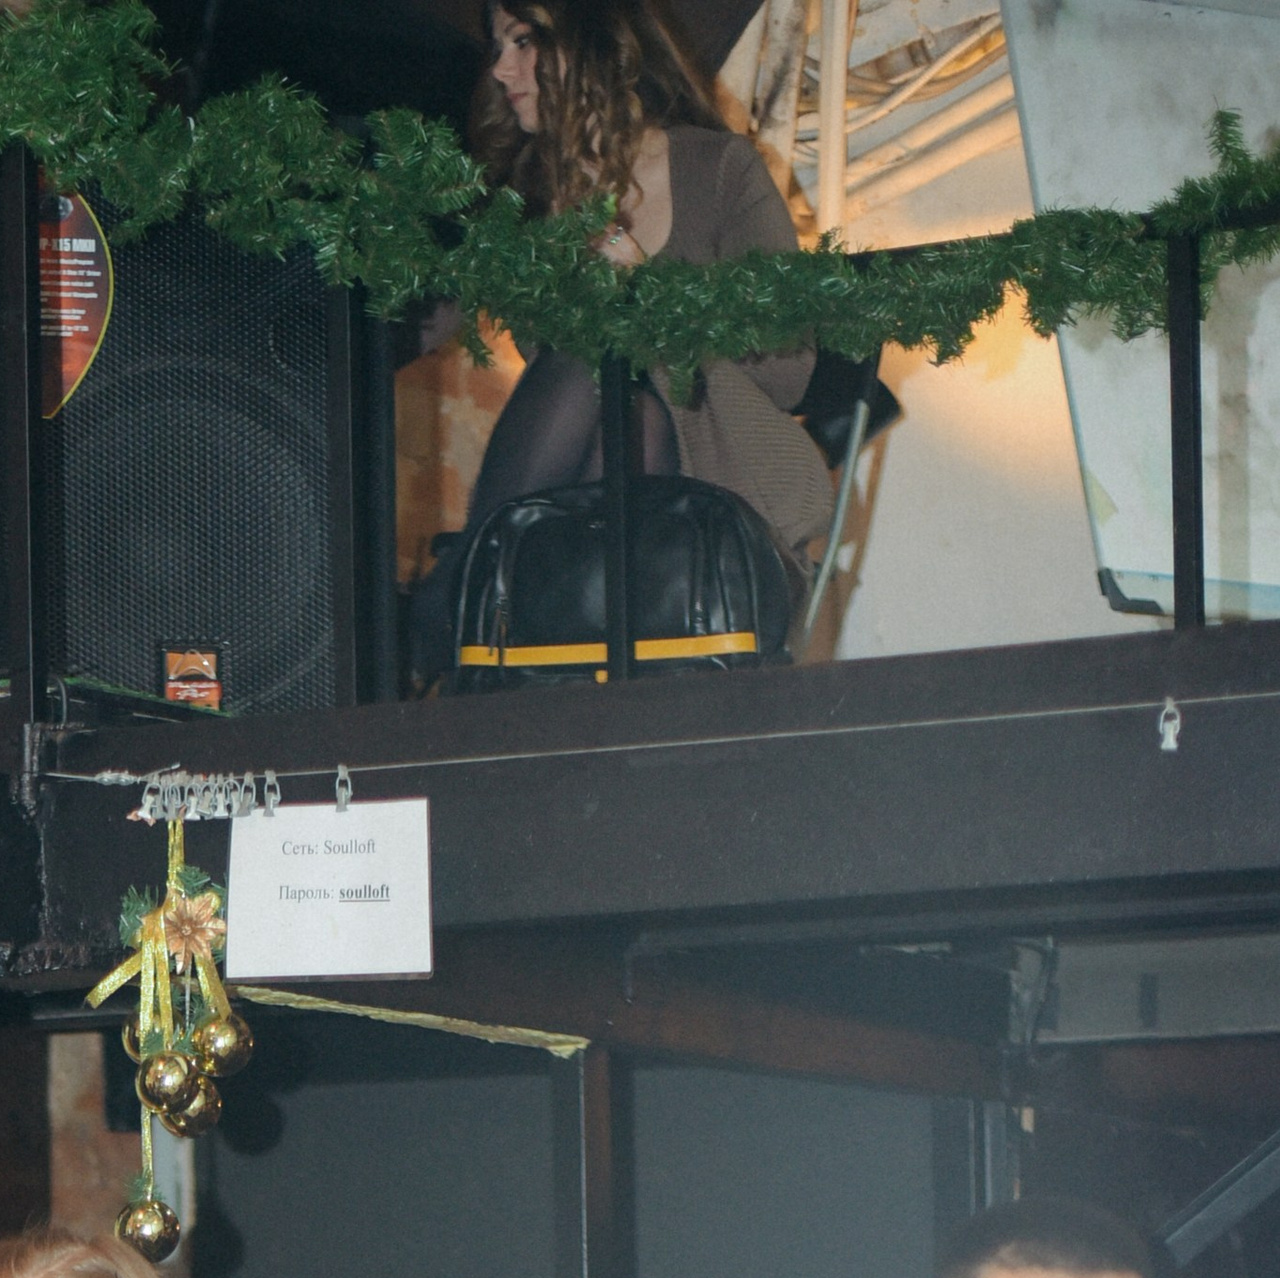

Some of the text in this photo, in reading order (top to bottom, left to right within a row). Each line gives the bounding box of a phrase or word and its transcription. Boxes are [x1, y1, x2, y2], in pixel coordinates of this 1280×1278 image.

[282, 838, 376, 855] Сеть: Soulloft
[279, 884, 391, 903] Пароль: soulloft
